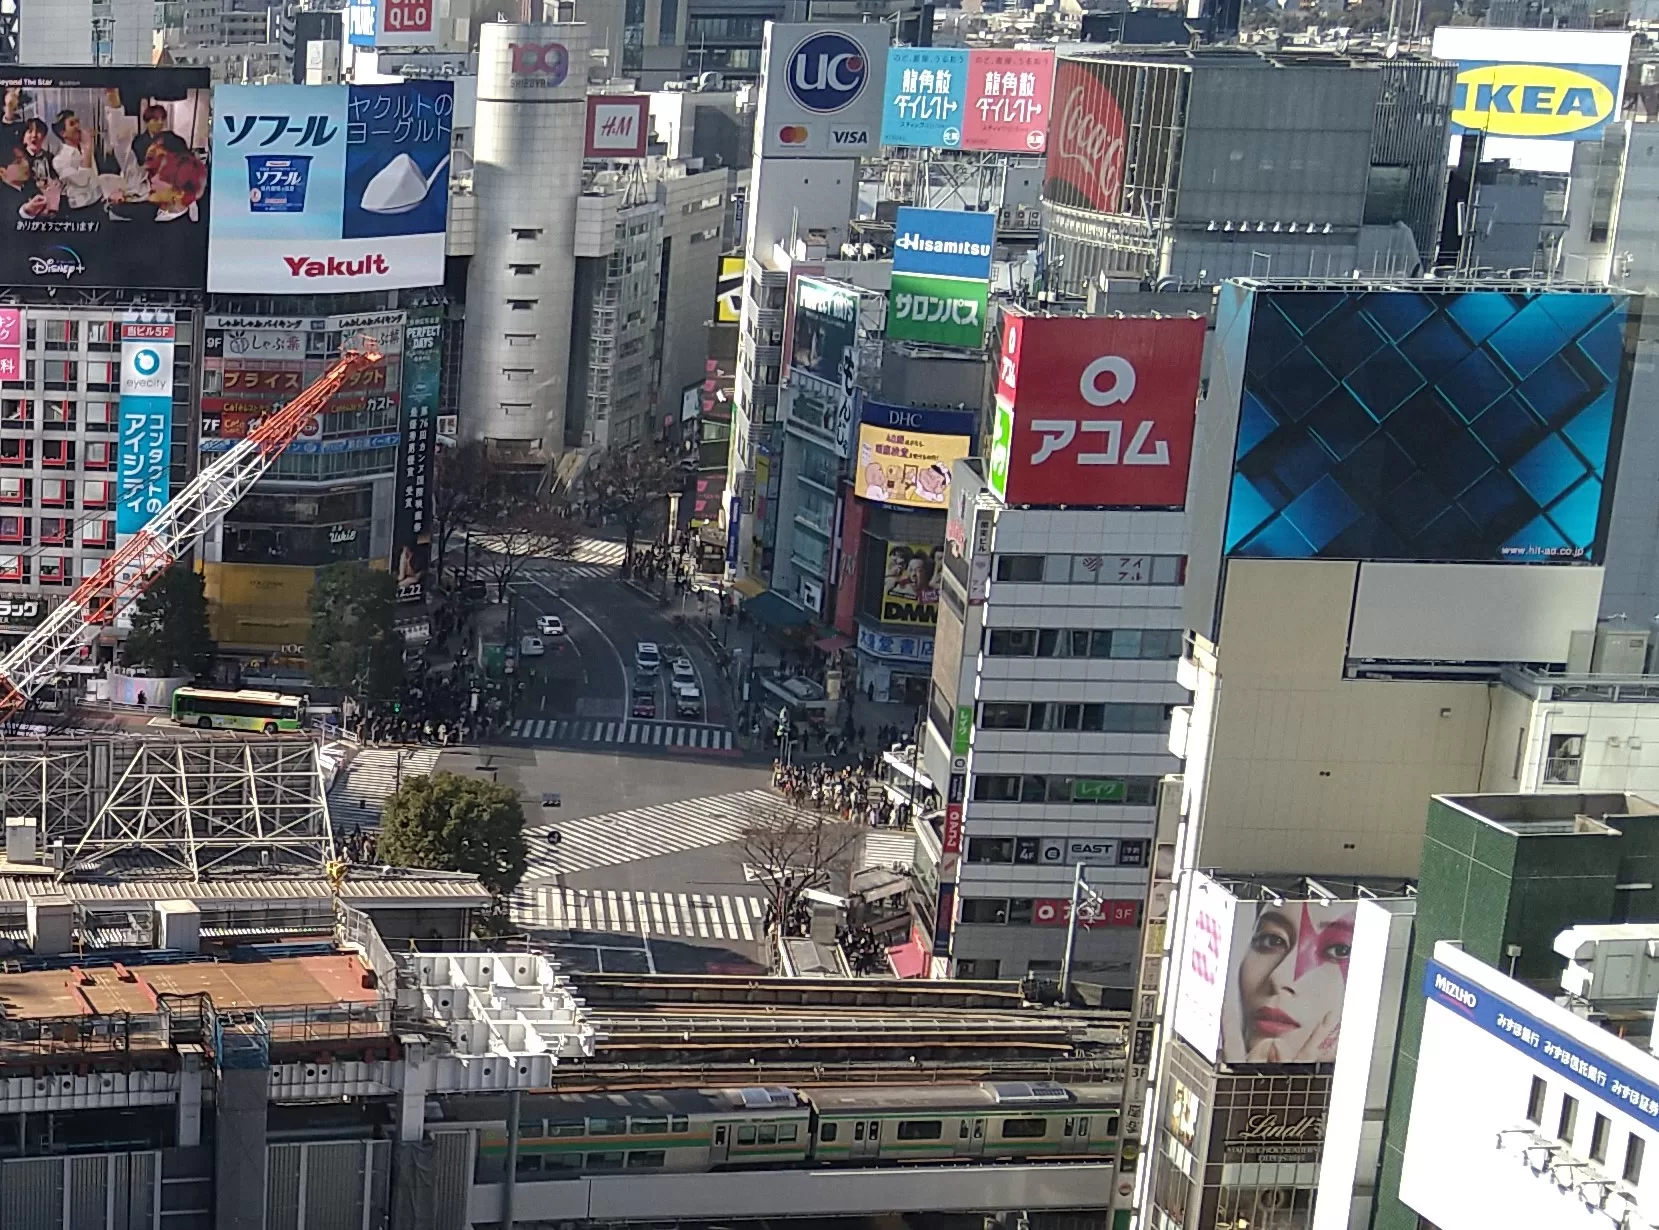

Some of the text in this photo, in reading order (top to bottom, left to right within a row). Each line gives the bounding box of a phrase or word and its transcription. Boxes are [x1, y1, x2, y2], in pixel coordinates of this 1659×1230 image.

[390, 7, 427, 28] QLO
[508, 42, 569, 88] 109
[24, 78, 37, 86] The
[903, 68, 952, 93] 龍角散
[984, 71, 1036, 96] 龍角散
[351, 94, 452, 121] ヤクルトの
[893, 94, 958, 120] ダイレクト
[975, 98, 1042, 123] ダイレクト
[1452, 82, 1599, 118] IKEA
[223, 114, 338, 147] ソフール
[347, 121, 452, 145] ヨーグルト
[601, 115, 633, 138] H&M
[832, 131, 868, 144] VISA
[255, 171, 302, 186] ソフール
[895, 232, 991, 257] Hisamitsu
[28, 256, 86, 280] Disney+
[283, 253, 390, 279] Yakult
[896, 293, 979, 327] サロンパス
[127, 326, 170, 337] 当ビル5F
[206, 337, 222, 348] 9F
[406, 324, 441, 338] PERFECT
[413, 336, 434, 349] DAYS
[126, 378, 167, 390] eyecity
[203, 419, 220, 432] 7F
[888, 409, 923, 428] DHC
[1030, 419, 1171, 466] アコム
[122, 413, 147, 513] アイシティ
[146, 414, 165, 513] コンタクトの
[396, 583, 422, 598] 2.22
[1081, 785, 1116, 797] レイク
[1019, 848, 1035, 860] 4F
[1071, 843, 1113, 854] EAST
[1115, 908, 1133, 919] 3F
[1435, 973, 1477, 1008] MIZUHO
[1495, 1013, 1540, 1048] みずほ銀行
[1543, 1040, 1608, 1088] みずほ信託銀行
[1132, 1067, 1147, 1078] 3F
[1239, 1114, 1317, 1139] Lindt
